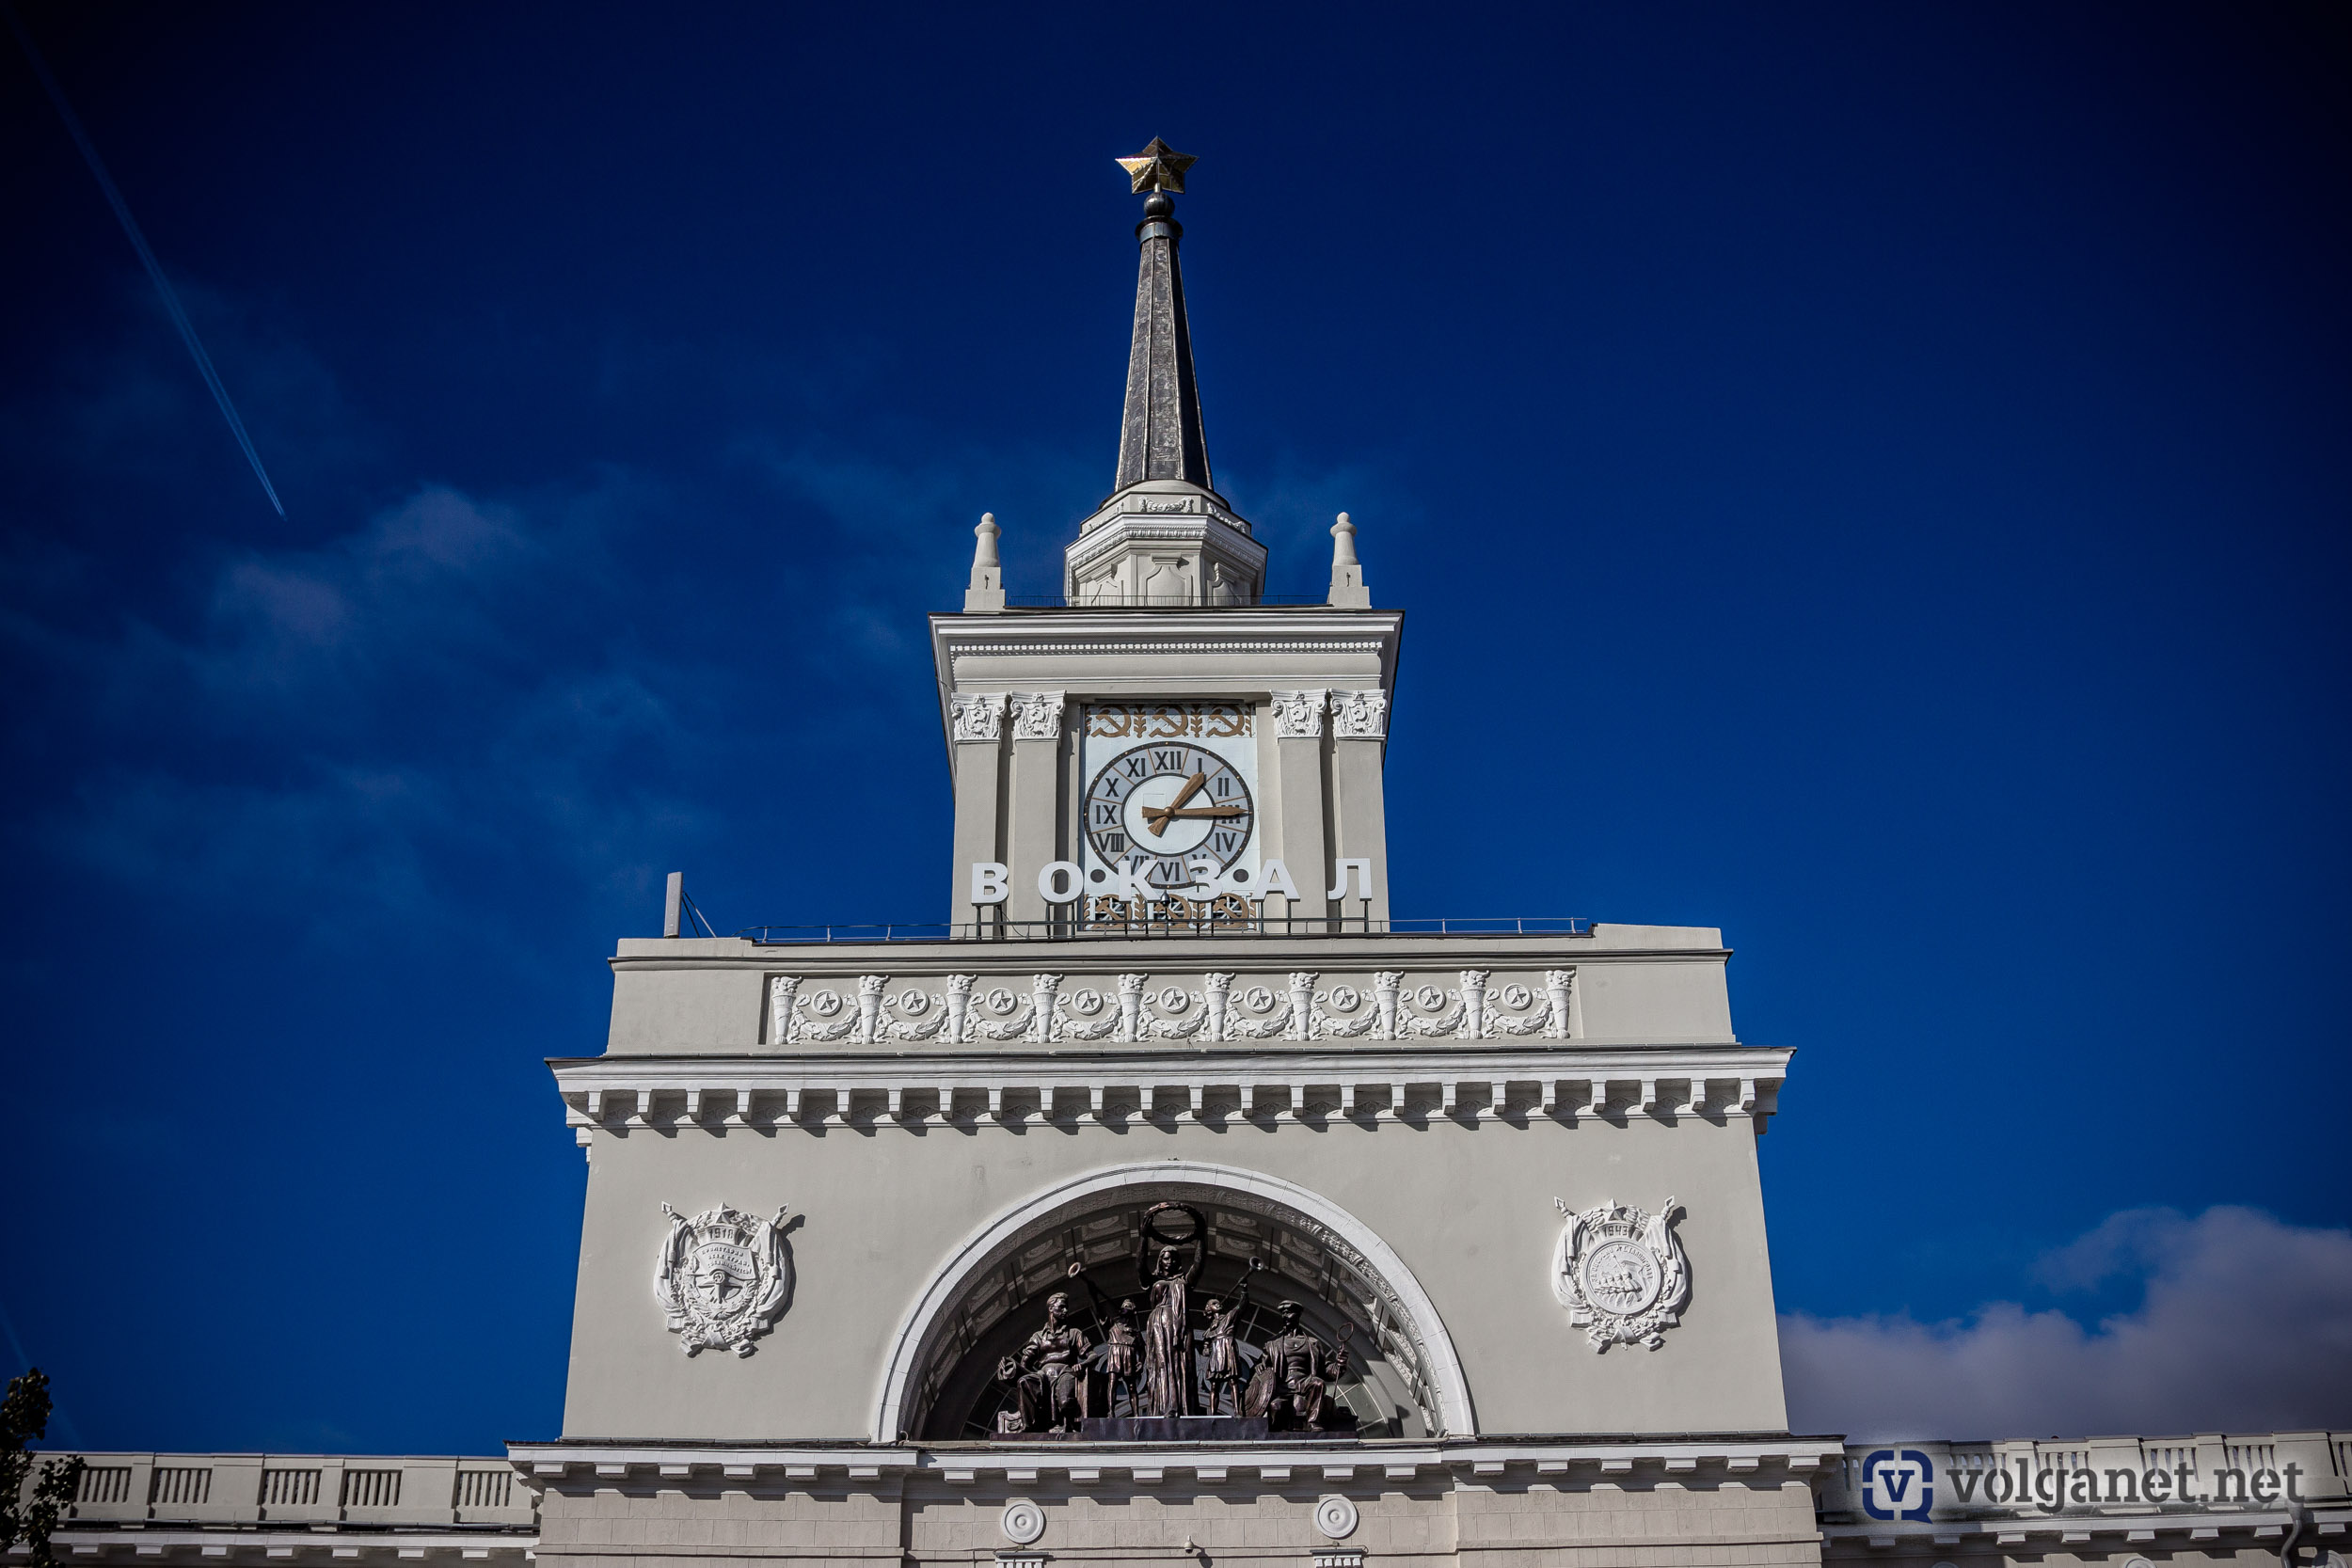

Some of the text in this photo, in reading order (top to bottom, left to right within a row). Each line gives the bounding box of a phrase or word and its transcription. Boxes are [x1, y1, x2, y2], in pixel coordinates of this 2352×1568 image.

[1126, 758, 1146, 777] XI
[1154, 752, 1181, 769] XII
[1105, 778, 1119, 797] X
[1217, 778, 1229, 796] II
[1096, 805, 1117, 824] IX
[1097, 833, 1124, 852] VIII
[1216, 832, 1236, 851] IV
[971, 857, 1372, 904] ВОКЗАЛ
[1160, 863, 1180, 881] VI
[1604, 1226, 1628, 1237] 1943
